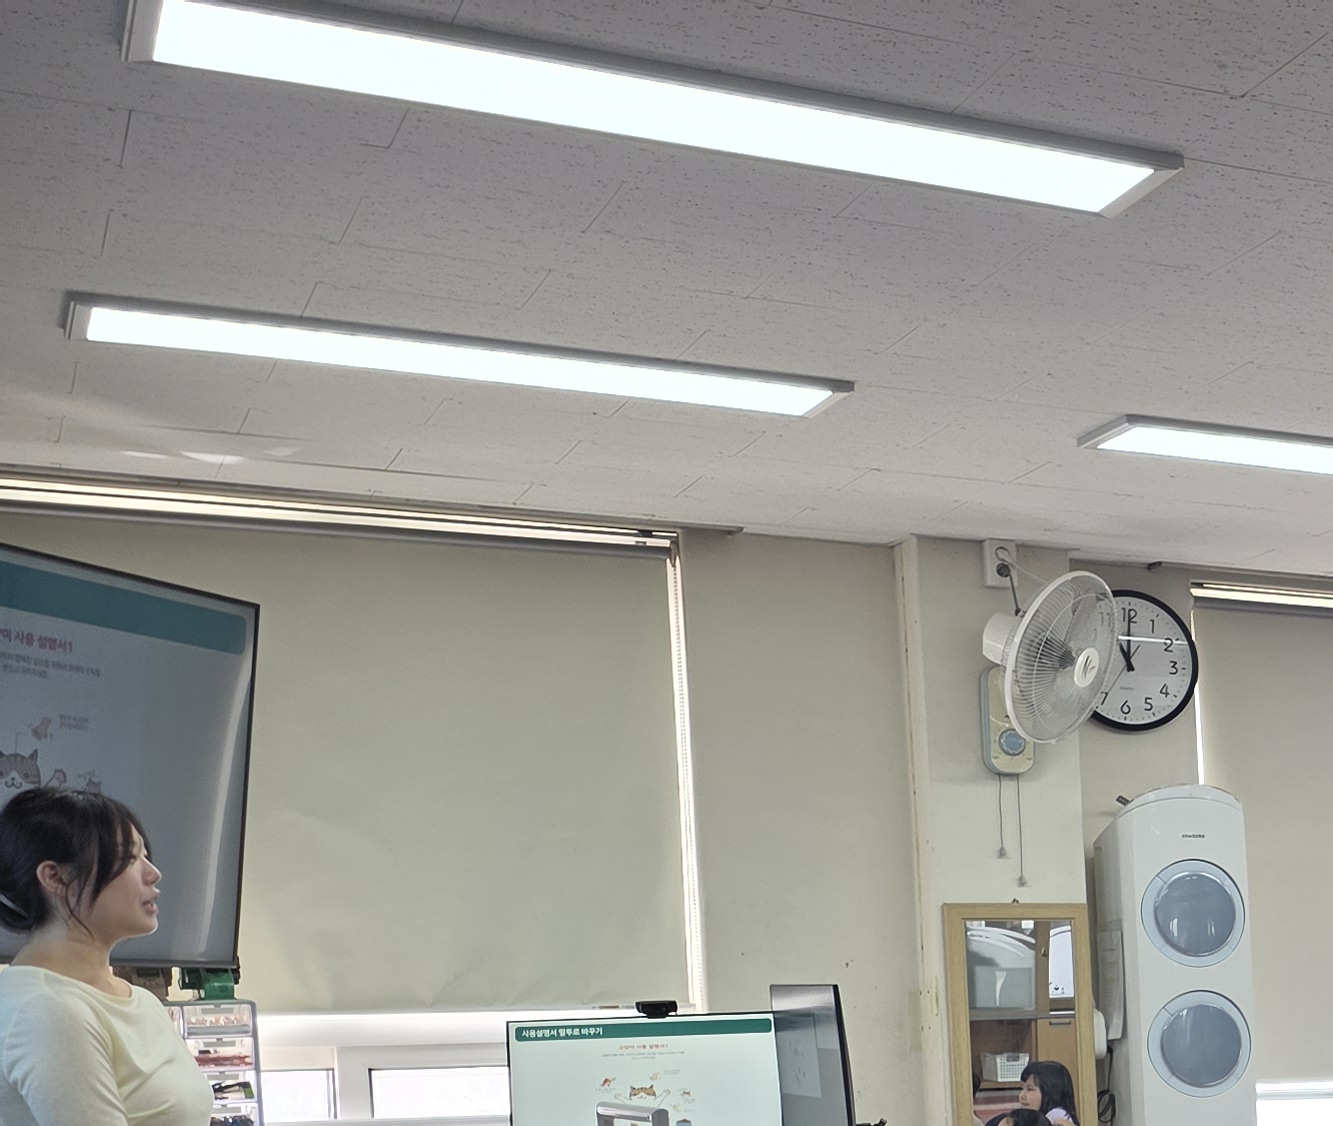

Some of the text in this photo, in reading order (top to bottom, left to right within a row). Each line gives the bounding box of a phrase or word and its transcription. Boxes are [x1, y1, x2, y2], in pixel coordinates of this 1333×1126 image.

[1121, 607, 1138, 624] 12
[1149, 618, 1156, 635] 1
[1163, 637, 1174, 653] 2
[1168, 660, 1179, 675] 3
[1159, 683, 1170, 698] 4
[1100, 691, 1109, 706] 7
[1144, 697, 1154, 711] 5
[1120, 700, 1131, 715] 6
